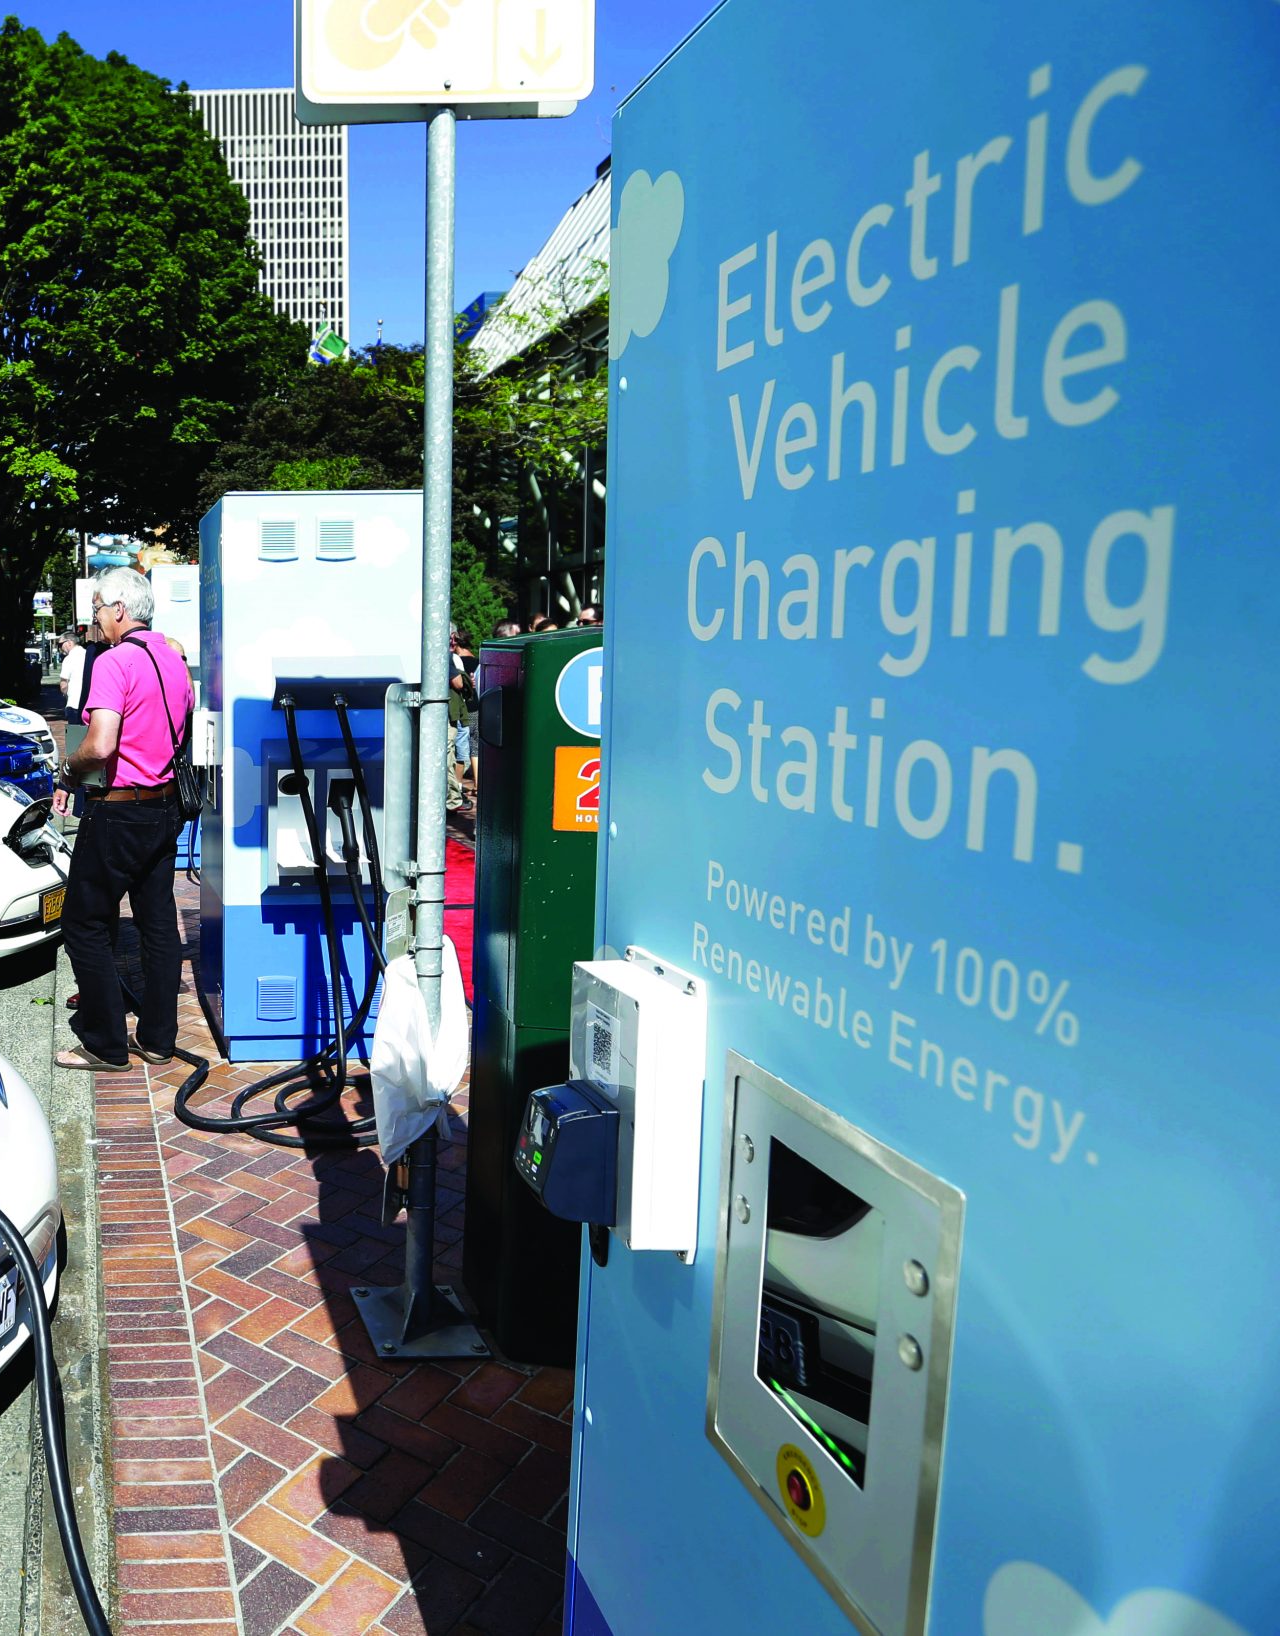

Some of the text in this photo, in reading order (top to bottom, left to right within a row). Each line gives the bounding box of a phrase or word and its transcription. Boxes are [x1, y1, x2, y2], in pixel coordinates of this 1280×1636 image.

[716, 63, 1149, 371] Electric
[729, 282, 1127, 501] Vehicle
[687, 489, 1175, 685] Charging
[702, 688, 1083, 874] Station.
[692, 921, 1100, 1167] Renewable Energy.
[706, 859, 1079, 1047] Powered by 100%
